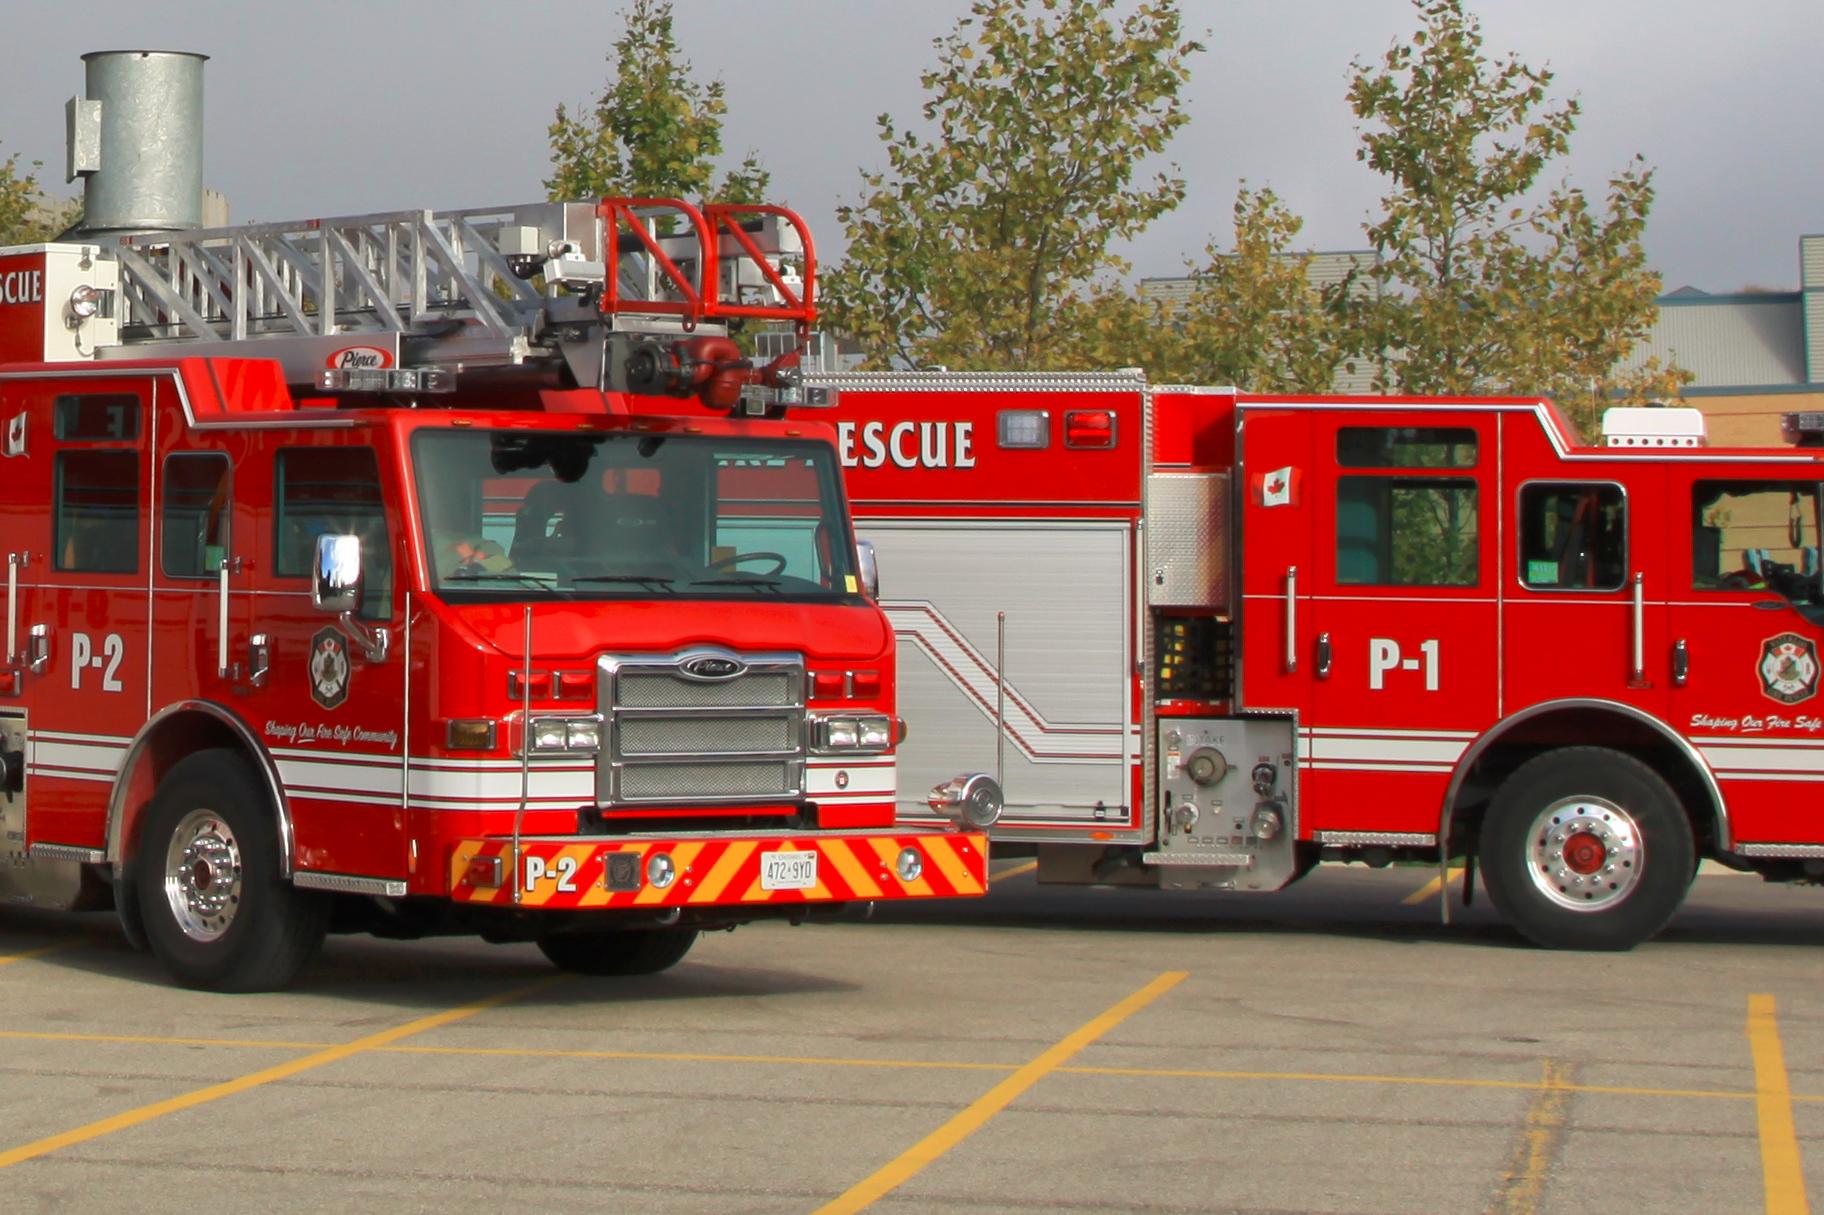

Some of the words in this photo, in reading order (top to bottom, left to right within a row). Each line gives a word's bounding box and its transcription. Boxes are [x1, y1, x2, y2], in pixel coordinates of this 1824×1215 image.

[340, 350, 378, 369] Pierce
[837, 421, 976, 468] ESCUE
[71, 632, 124, 692] P-2
[1369, 638, 1439, 691] P-1
[264, 720, 296, 744] Shaping
[353, 725, 397, 750] Community
[1690, 714, 1738, 730] Shaping
[1741, 715, 1763, 728] Our
[1766, 715, 1791, 729] Fire
[1794, 716, 1822, 732] Safe
[525, 856, 577, 892] P-2
